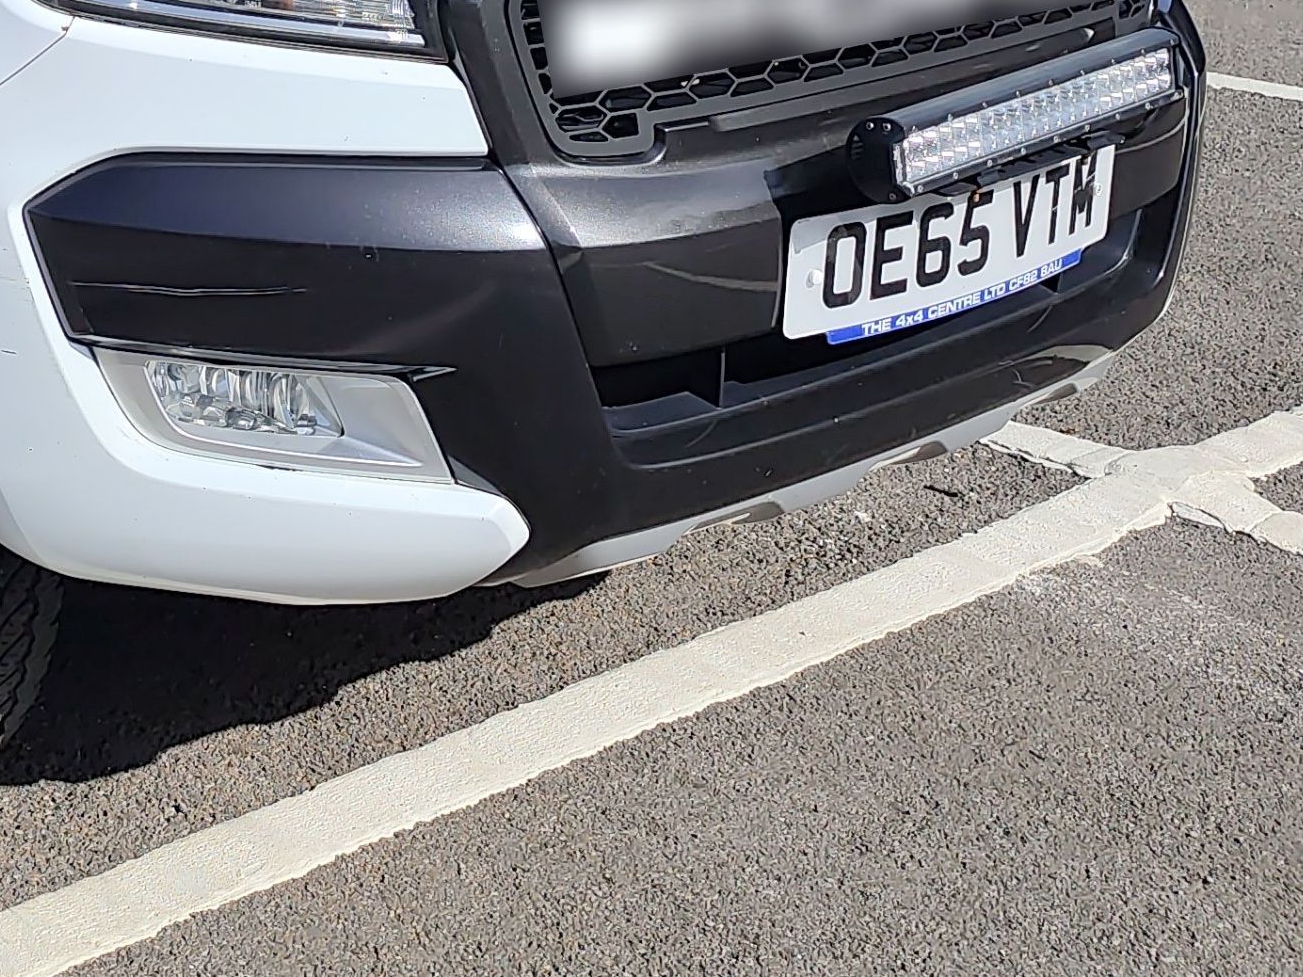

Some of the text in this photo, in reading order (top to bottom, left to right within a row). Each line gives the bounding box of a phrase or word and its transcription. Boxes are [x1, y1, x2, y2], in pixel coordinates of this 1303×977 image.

[822, 150, 1097, 310] OE65 VTM
[861, 318, 892, 336] THE
[895, 310, 924, 327] 4x4
[927, 291, 981, 319] CENTRE
[983, 283, 1006, 301] LTD
[1008, 270, 1038, 291] CF82
